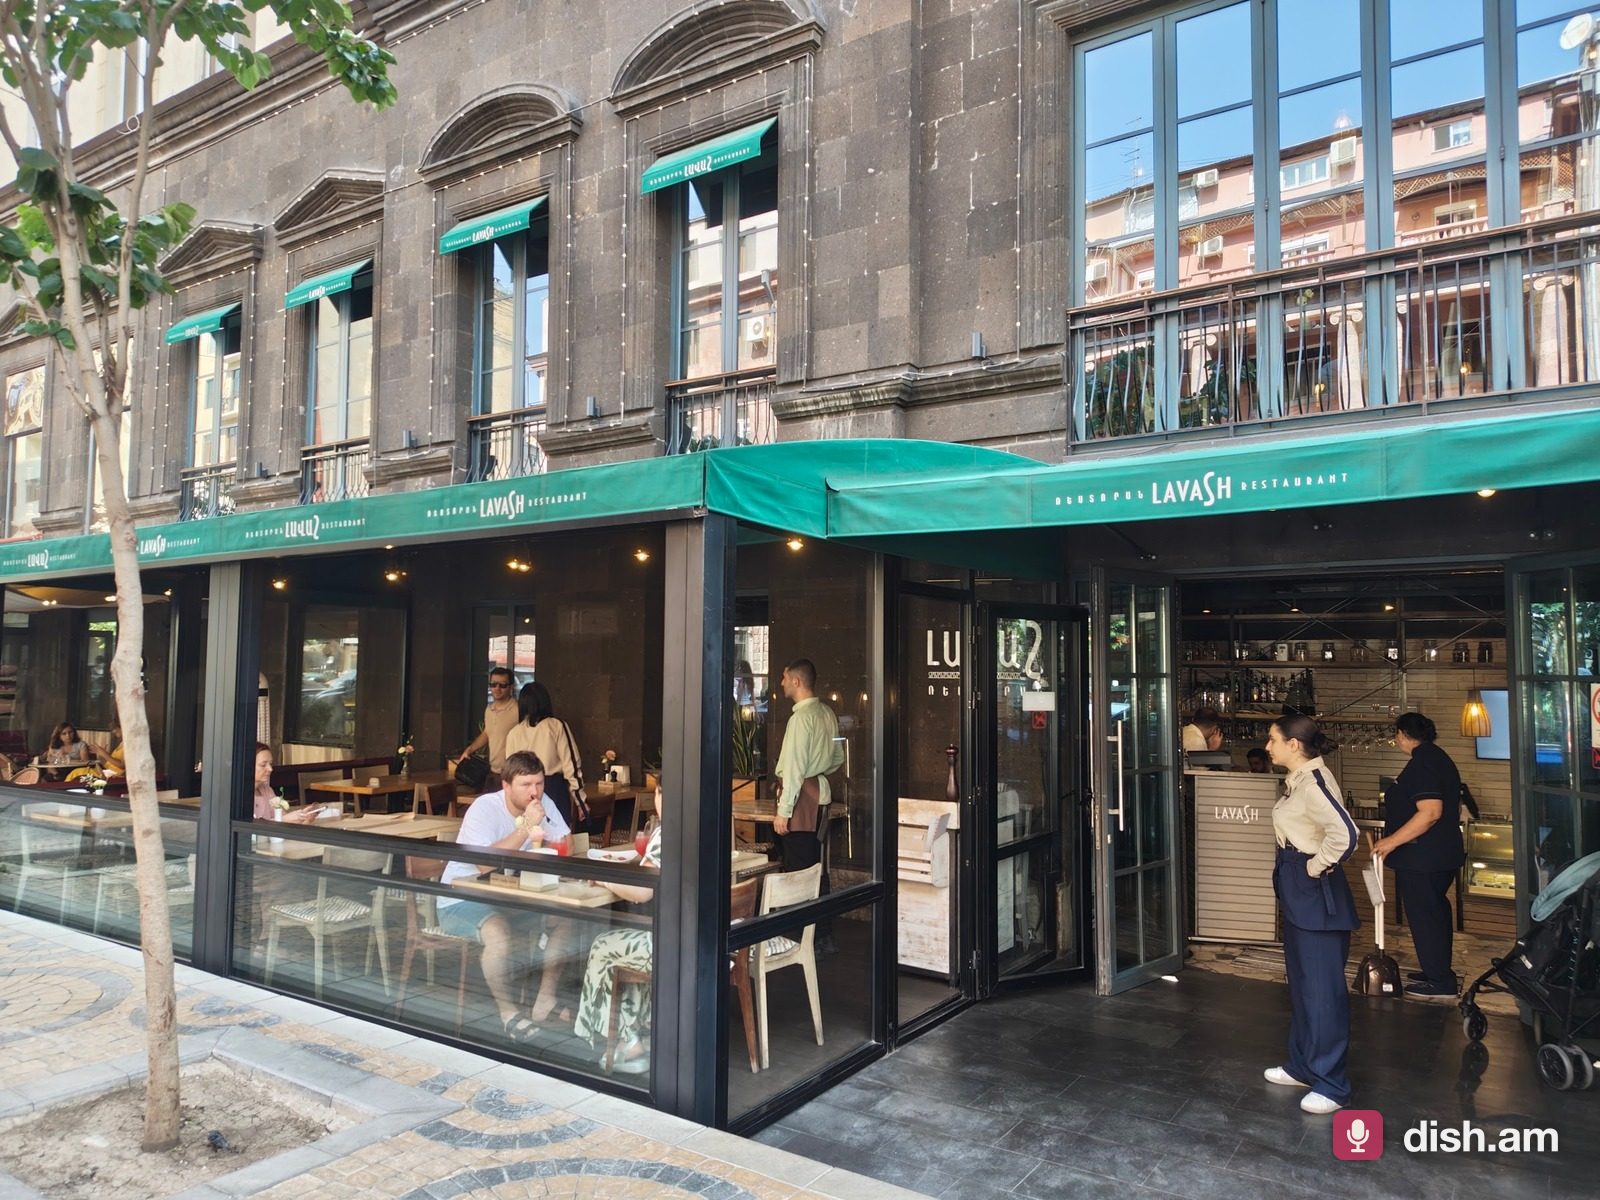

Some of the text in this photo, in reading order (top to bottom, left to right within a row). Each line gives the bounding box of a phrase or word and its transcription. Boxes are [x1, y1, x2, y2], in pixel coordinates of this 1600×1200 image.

[472, 226, 494, 242] LAVASH
[1153, 472, 1231, 506] LAVASH
[1240, 472, 1349, 491] RESTAURANT
[480, 490, 524, 520] LAVASH
[528, 491, 588, 507] RESTAURANT
[285, 515, 320, 540] ԼԱՎԱՇ
[140, 534, 167, 557] LAVASH
[1215, 805, 1258, 823] LAVASH
